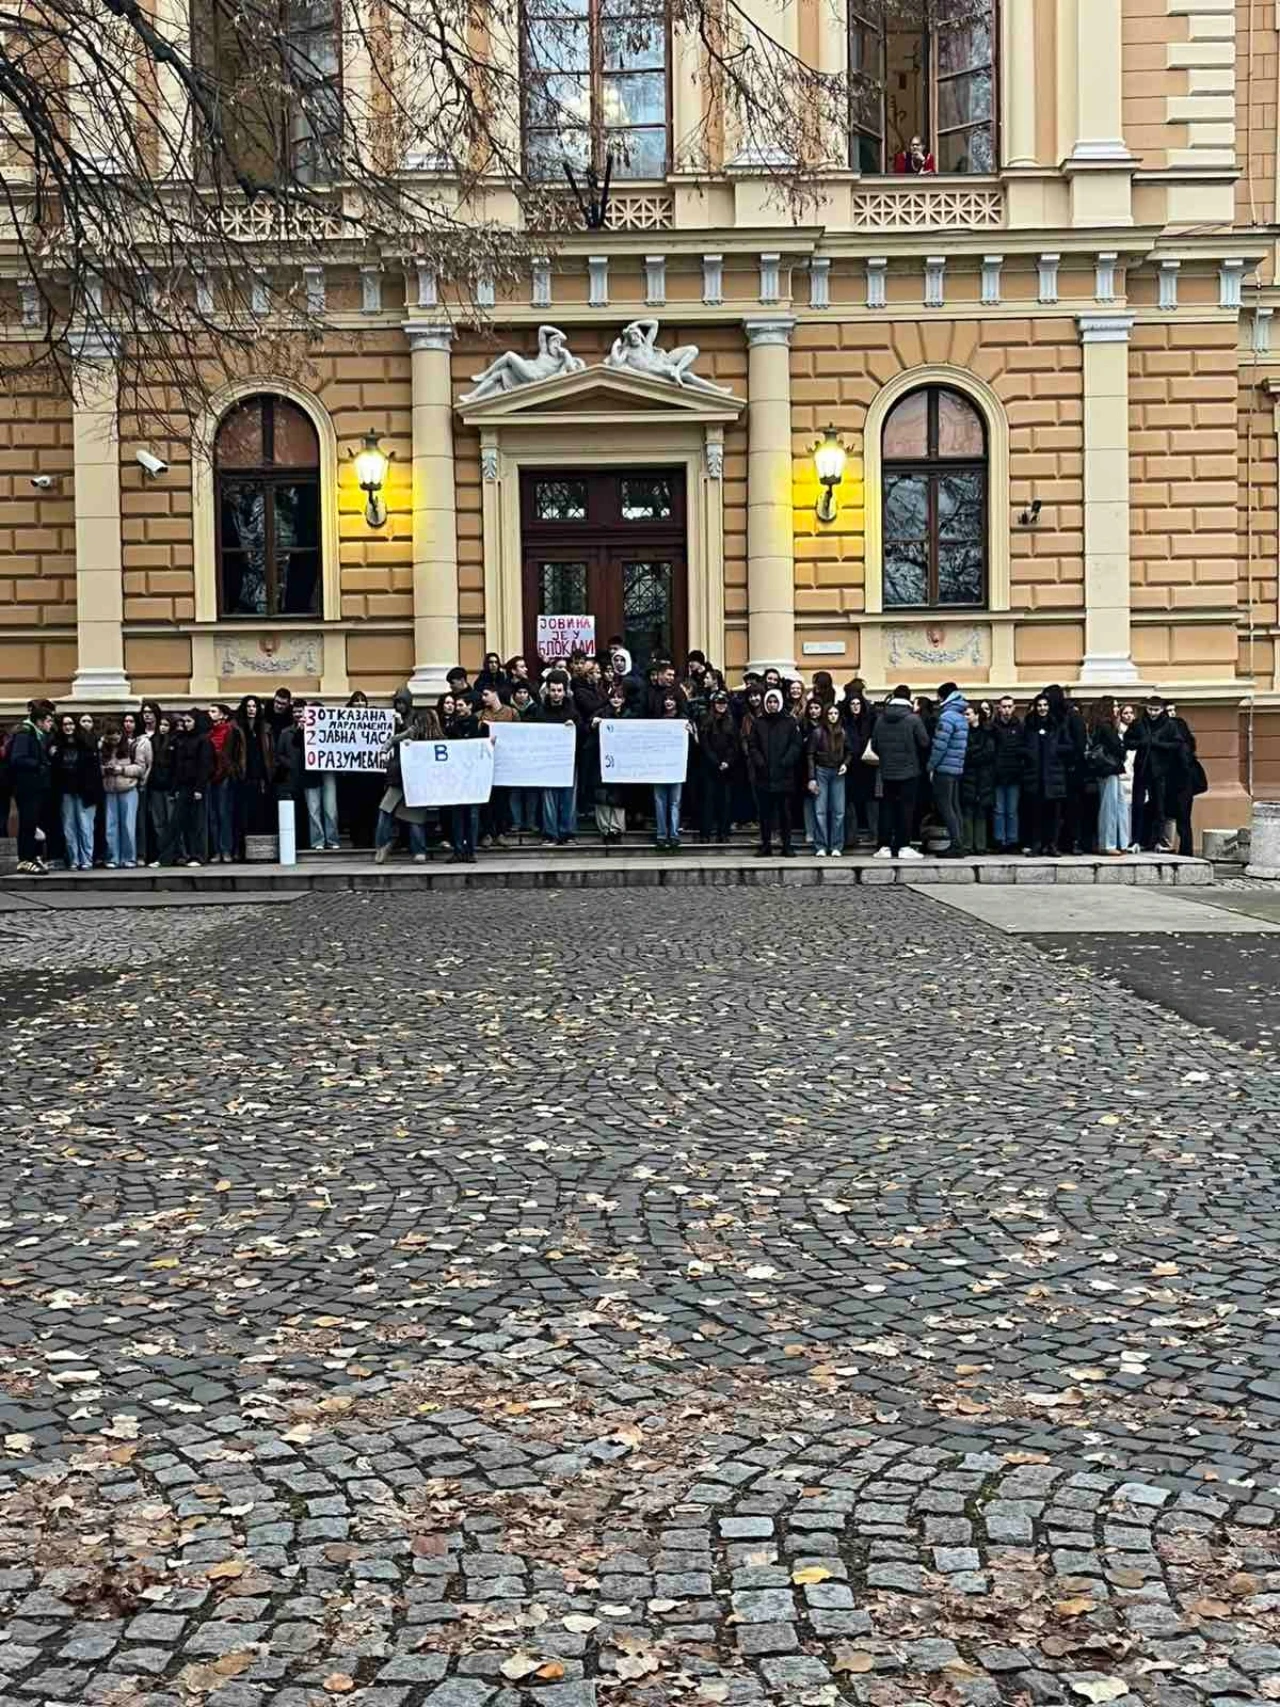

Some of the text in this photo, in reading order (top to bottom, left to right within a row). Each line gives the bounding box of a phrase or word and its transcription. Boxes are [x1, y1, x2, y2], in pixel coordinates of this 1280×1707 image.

[540, 618, 591, 629] ЈОВИНА
[552, 629, 580, 641] ЈЕ У
[318, 708, 387, 721] ОТКАЗАНА
[318, 729, 357, 744] ЈАВНА
